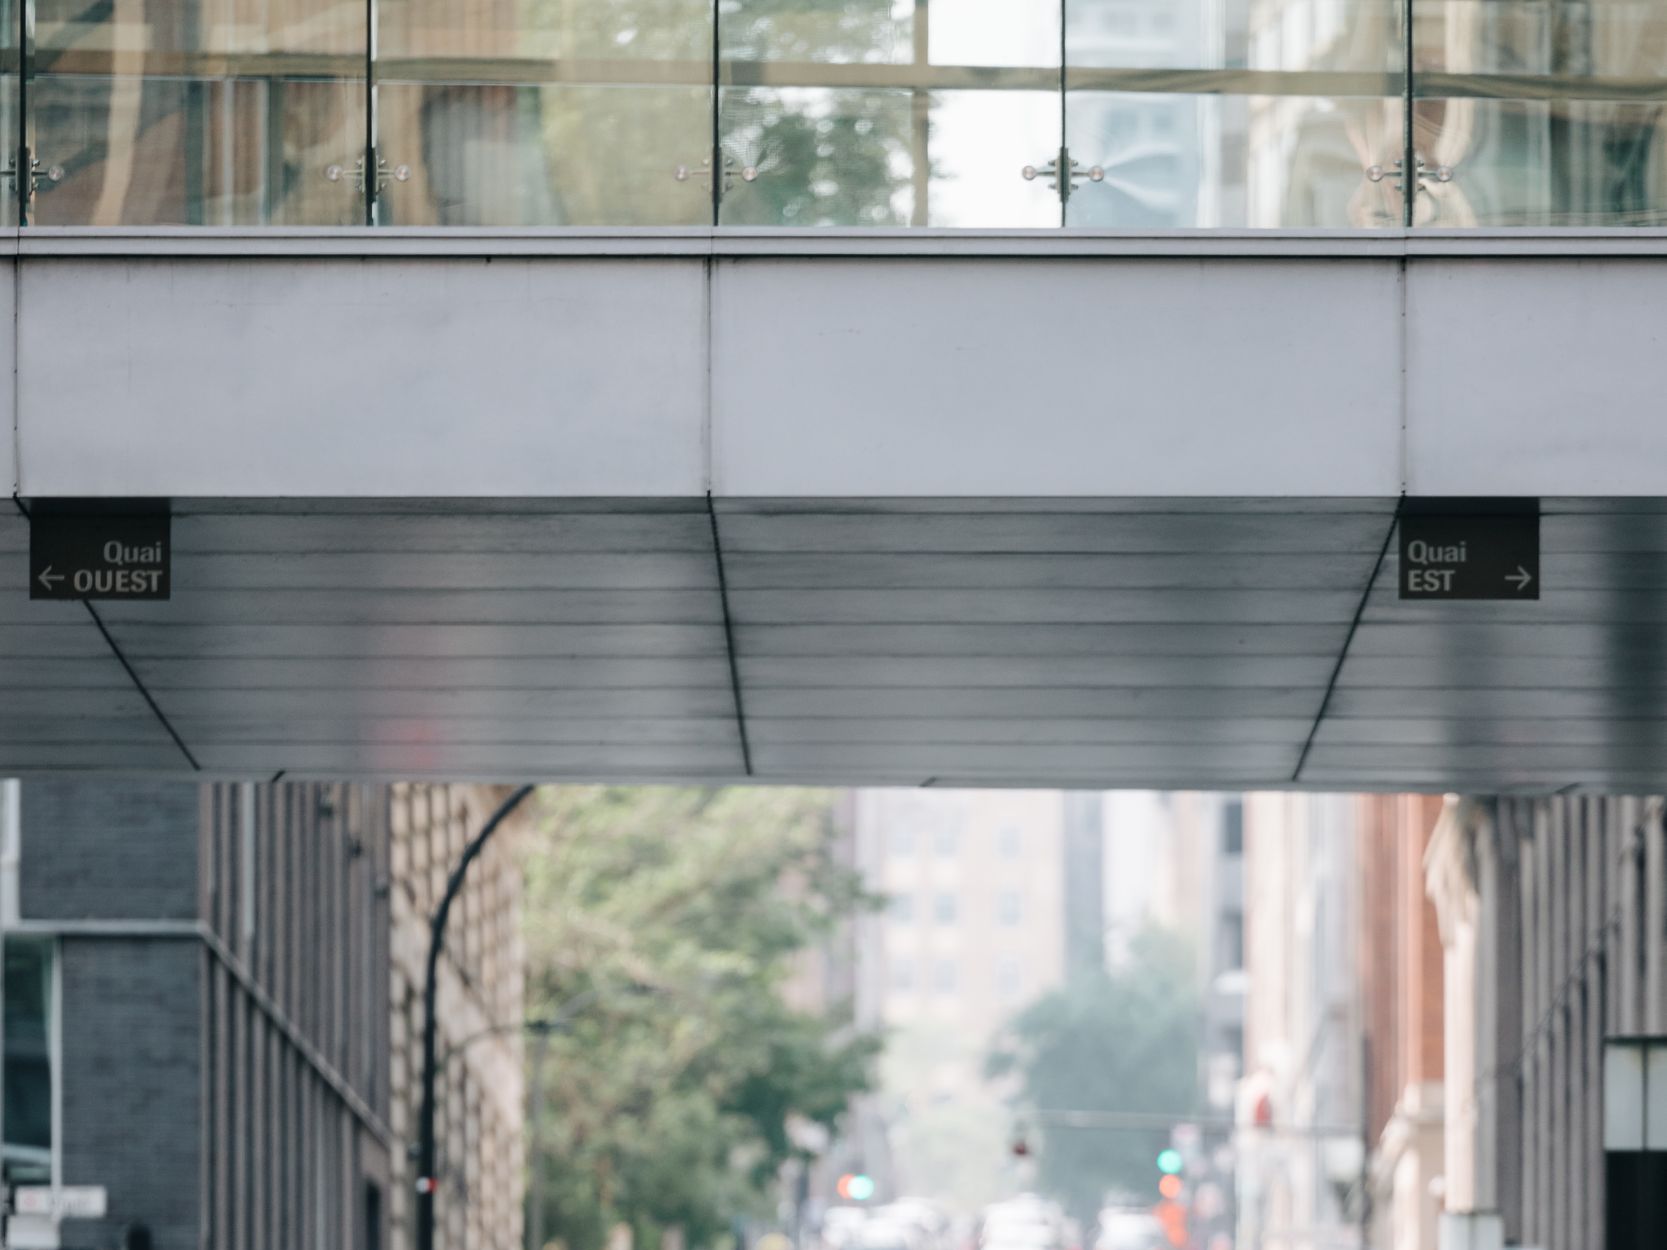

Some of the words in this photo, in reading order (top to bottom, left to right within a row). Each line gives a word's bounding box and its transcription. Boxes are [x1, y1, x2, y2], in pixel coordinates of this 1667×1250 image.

[103, 540, 162, 565] Quai
[1407, 540, 1467, 565] Quai
[73, 569, 163, 593] OUEST
[1407, 569, 1456, 592] EST
